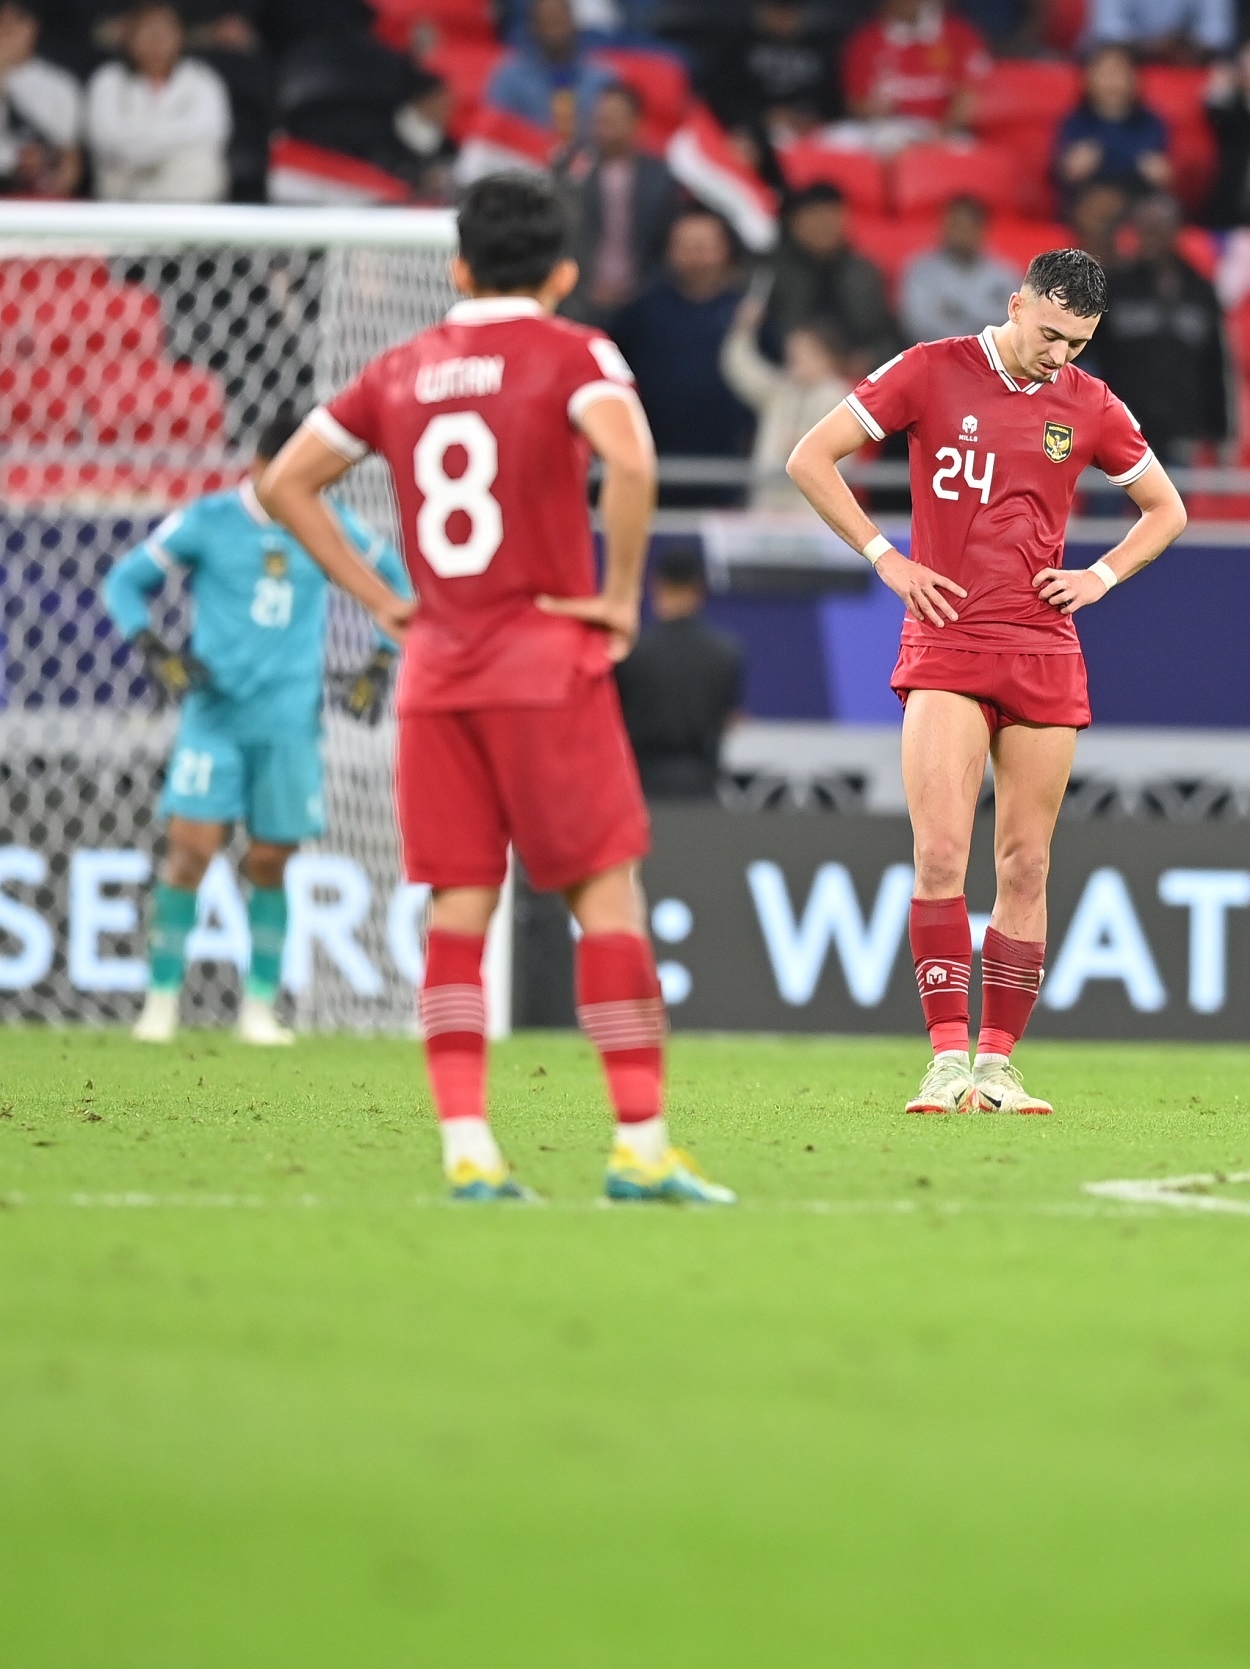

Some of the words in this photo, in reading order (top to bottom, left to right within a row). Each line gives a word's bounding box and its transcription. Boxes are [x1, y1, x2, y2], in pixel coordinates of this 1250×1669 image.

[413, 410, 504, 579] 8
[932, 446, 995, 504] 24
[252, 577, 294, 628] 21
[171, 750, 213, 795] 21
